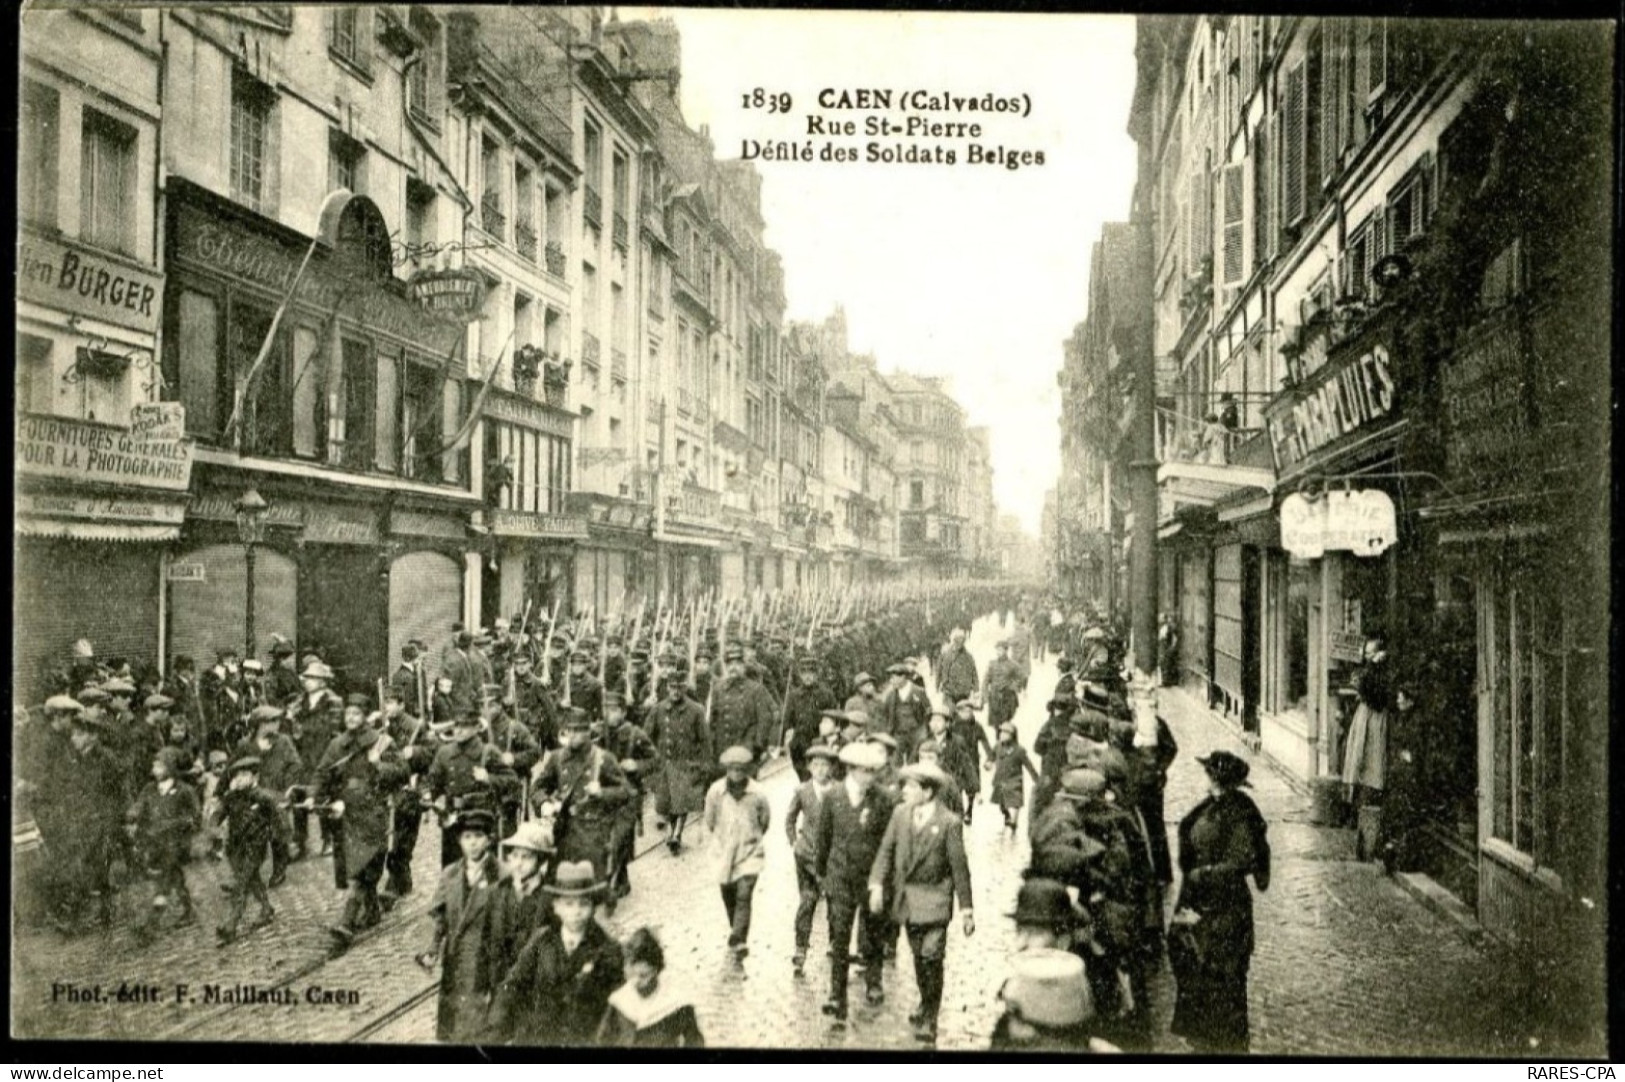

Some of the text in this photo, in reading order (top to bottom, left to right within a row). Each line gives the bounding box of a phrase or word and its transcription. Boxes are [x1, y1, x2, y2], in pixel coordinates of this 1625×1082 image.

[57, 250, 155, 317] BURGER
[1293, 343, 1395, 457] PARAPLUIES
[17, 441, 185, 482] POUR LA PHOTOGRAPHIE
[18, 417, 114, 452] FOURNITURES
